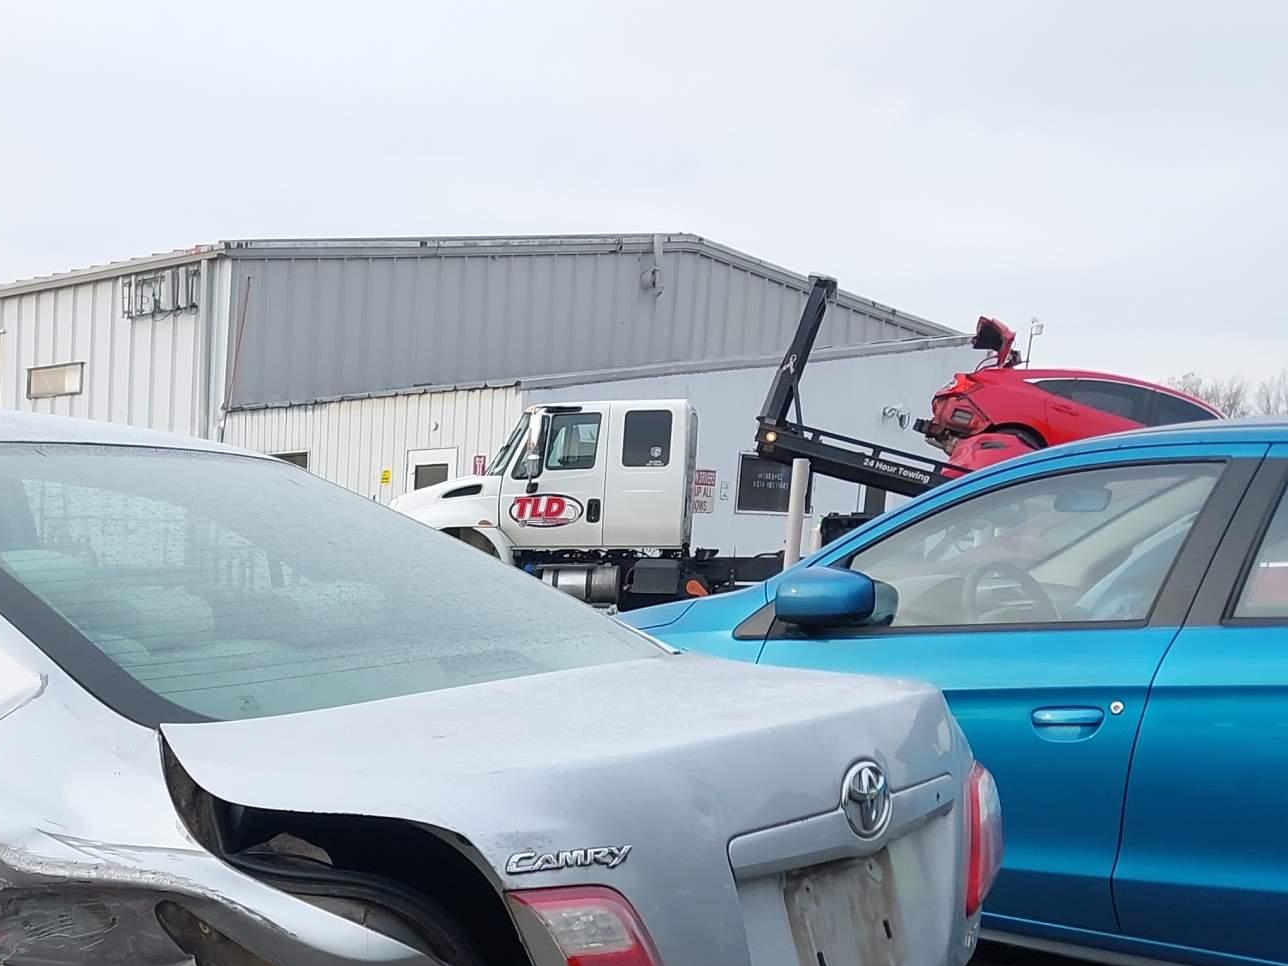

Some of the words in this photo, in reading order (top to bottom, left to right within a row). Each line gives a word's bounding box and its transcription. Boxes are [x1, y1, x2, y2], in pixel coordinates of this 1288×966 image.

[863, 458, 875, 467] 24
[875, 460, 897, 473] Hour
[898, 466, 930, 484] Towing
[515, 498, 565, 519] TLD
[505, 845, 632, 874] CAMRY
